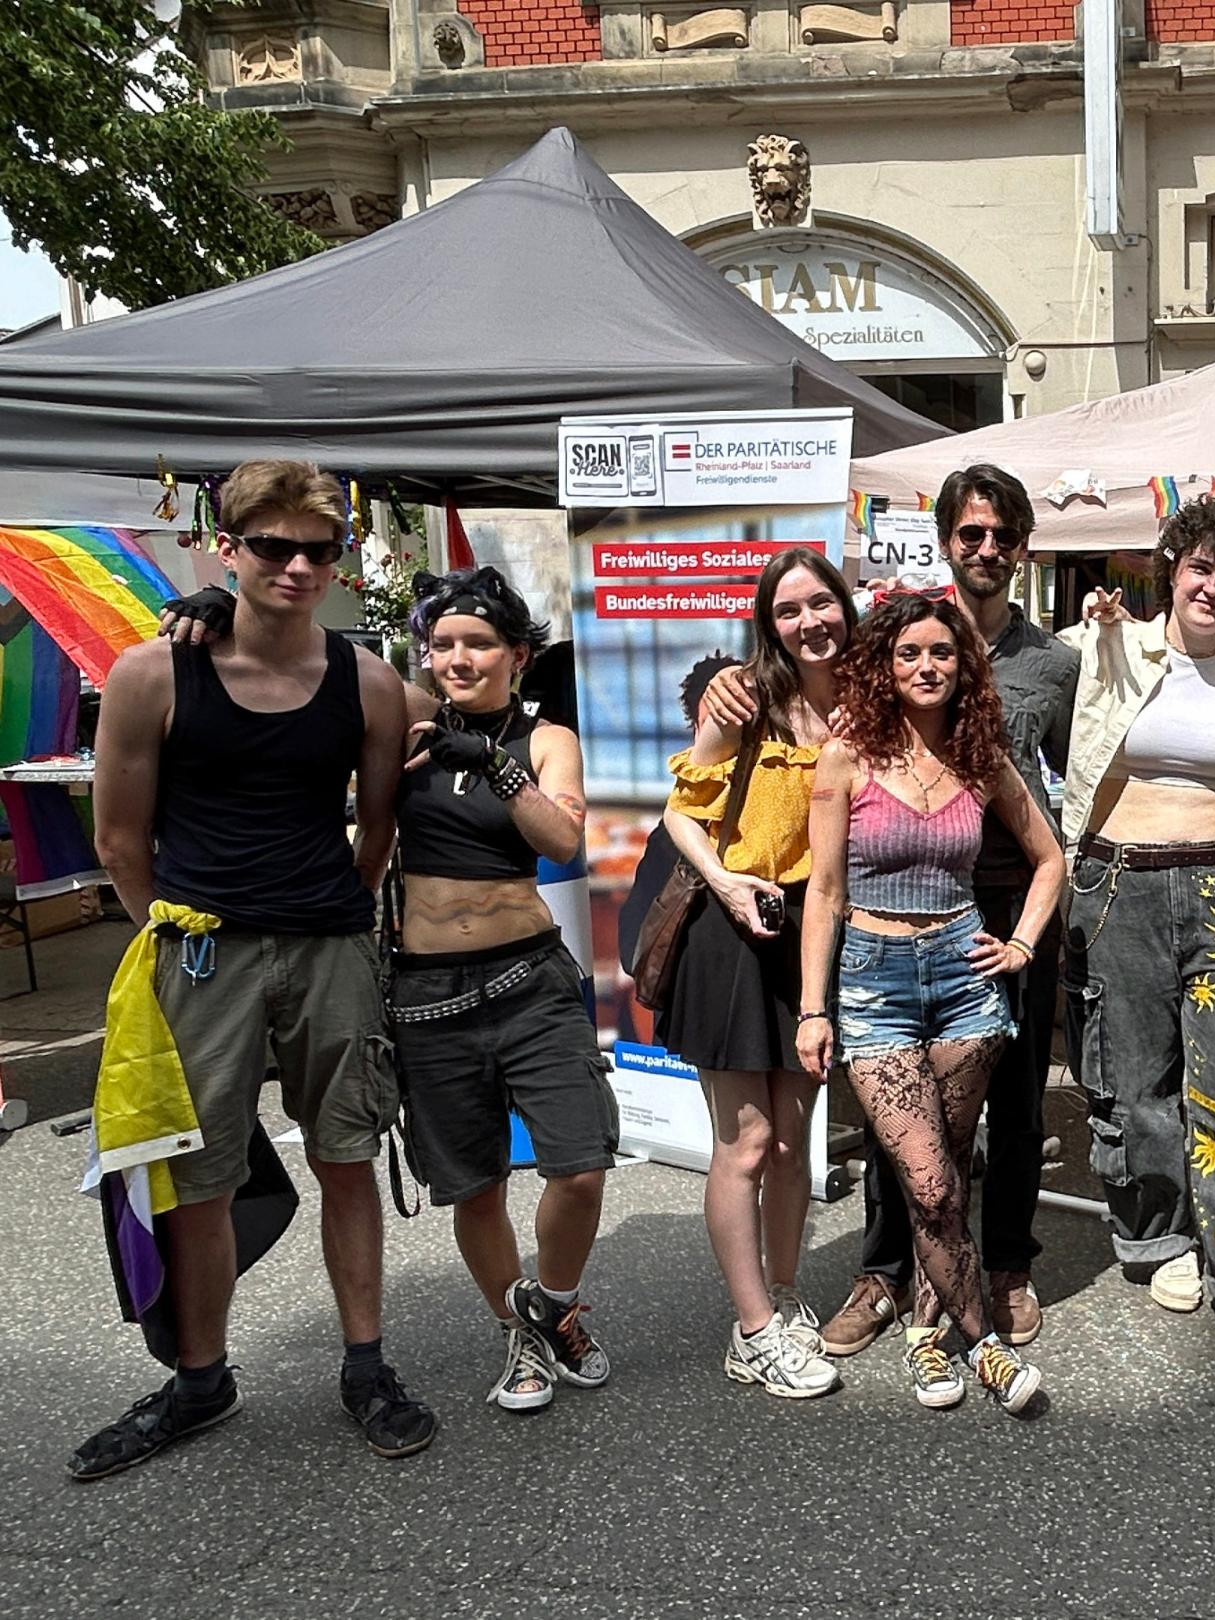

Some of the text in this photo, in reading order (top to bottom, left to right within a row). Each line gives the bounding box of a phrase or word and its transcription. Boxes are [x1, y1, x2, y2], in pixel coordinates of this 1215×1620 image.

[803, 325, 924, 353] Spezialitäten
[572, 443, 622, 467] SCAN
[695, 438, 837, 459] DER PARITÄTISCHE
[577, 459, 619, 477] Here
[770, 460, 811, 470] Saarland
[600, 549, 773, 572] Freiwilliges Soziales
